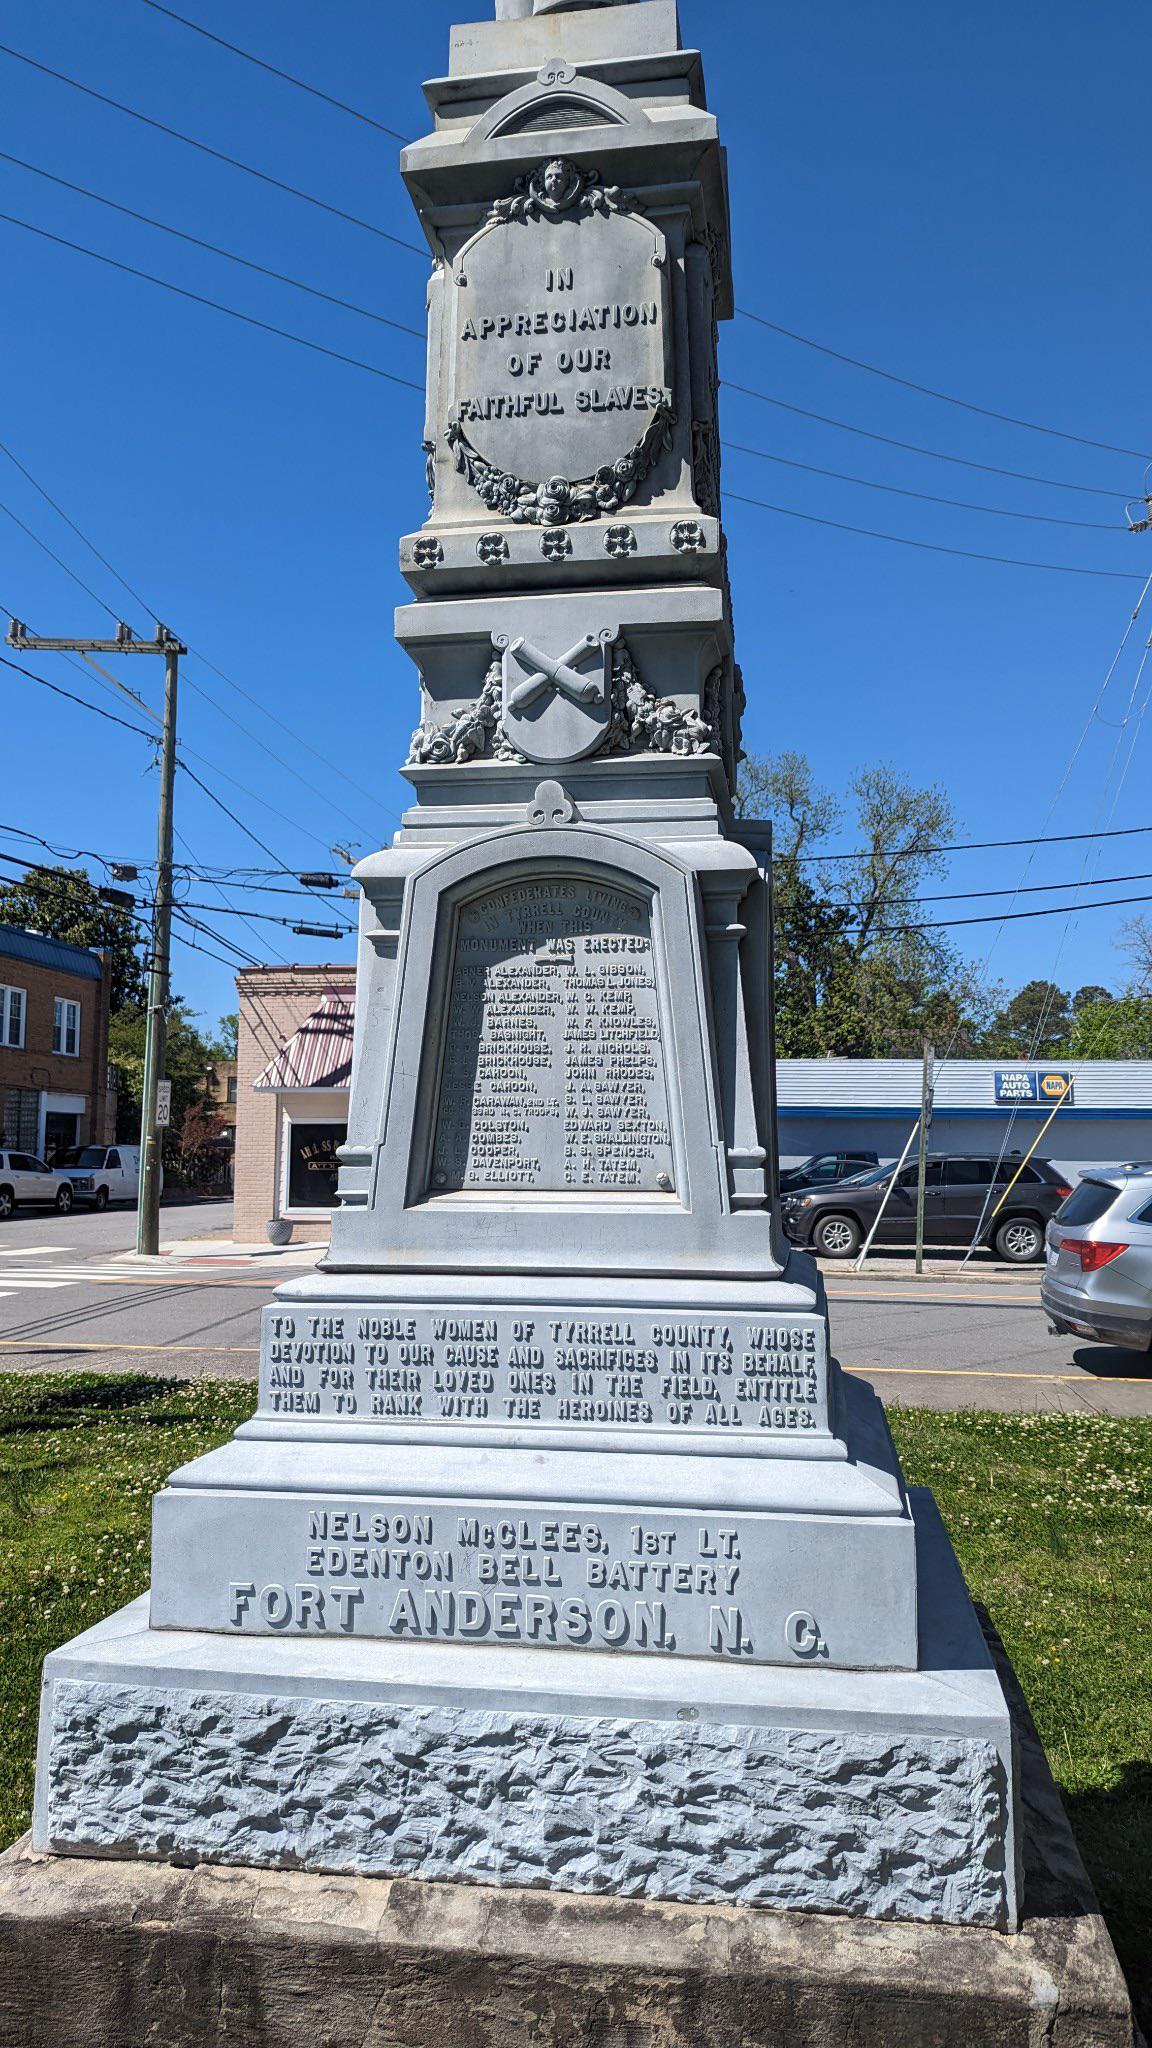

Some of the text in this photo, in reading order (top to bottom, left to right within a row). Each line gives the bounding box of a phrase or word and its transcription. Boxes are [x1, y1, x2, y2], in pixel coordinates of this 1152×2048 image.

[545, 268, 573, 291] IN
[461, 302, 657, 340] APPRECIATION
[507, 347, 611, 376] OF OUR
[458, 392, 564, 422] FAITHFUL
[480, 886, 627, 914] CONFEDERATES LIVING
[484, 903, 627, 932] IN TYRRELL COUNTY
[518, 920, 592, 934] WHEN THIS
[460, 938, 536, 953] MONUMENT
[546, 937, 575, 953] WAS
[455, 966, 561, 978] ABNER ALEXANDER,
[566, 964, 646, 977] W. L. GIBSON,
[484, 979, 550, 990] ALEXANDER,
[563, 977, 656, 990] THOMAS L. JONES,
[453, 992, 563, 1004] NELSON ALEXANDER,
[566, 992, 578, 1003] W.
[487, 1005, 555, 1017] ALEXANDER,
[566, 1003, 636, 1016] W. W. KEMP,
[487, 1018, 537, 1029] BARNES,
[565, 1017, 579, 1029] W.
[599, 1017, 656, 1029] KNOWLES,
[490, 1030, 546, 1042] BASNIGHT,
[562, 1030, 596, 1041] JAMES
[478, 1042, 552, 1055] BRICKHOUSE,
[564, 1043, 575, 1054] J.
[596, 1042, 650, 1055] NICHOLS,
[478, 1056, 552, 1068] BRICKHOUSE,
[564, 1056, 657, 1068] JAMES PHELPS,
[478, 1068, 527, 1080] CAHOON,
[564, 1068, 654, 1080] JOHN RHODES,
[1002, 1074, 1030, 1082] NAPA
[490, 1081, 537, 1094] CAHOON,
[564, 1082, 646, 1094] J. A. SAWYER,
[1002, 1082, 1030, 1090] AUTO
[1046, 1081, 1064, 1090] NAPA
[596, 1094, 647, 1107] SAWYER,
[158, 1104, 168, 1120] 20
[565, 1106, 650, 1120] W. J. SAWYER,
[474, 1120, 529, 1132] COLSTON,
[564, 1120, 667, 1133] EDWARD SEXTON,
[564, 1132, 578, 1144] W.
[581, 1132, 592, 1144] E.
[470, 1145, 519, 1157] COOPER,
[596, 1146, 654, 1158] SPENCER,
[472, 1158, 540, 1171] DAVENPORT,
[564, 1159, 641, 1173] A. H. TATEM,
[484, 1170, 534, 1184] ELLIOTT,
[582, 1172, 594, 1183] E.
[270, 1316, 814, 1352] TO THE NOBLE WOMEN OF TYRRELL COUNTY, WHOSE
[270, 1342, 816, 1380] DEVOTION TO OUR CAUSE AND SACRIFICES IN ITS BEHALF,
[269, 1366, 816, 1402] AND FOR THEIR LOVED ONES IN THE FIELD, ENTITLE
[269, 1391, 816, 1428] THEM TO RANK WITH THE HEROINES OF ALL AGES.
[308, 1511, 433, 1545] NELSON
[698, 1528, 740, 1558] LT.
[306, 1547, 739, 1594] EDENTON BELL BATTERY
[229, 1582, 829, 1658] FORT ANDERSON, N. C.
